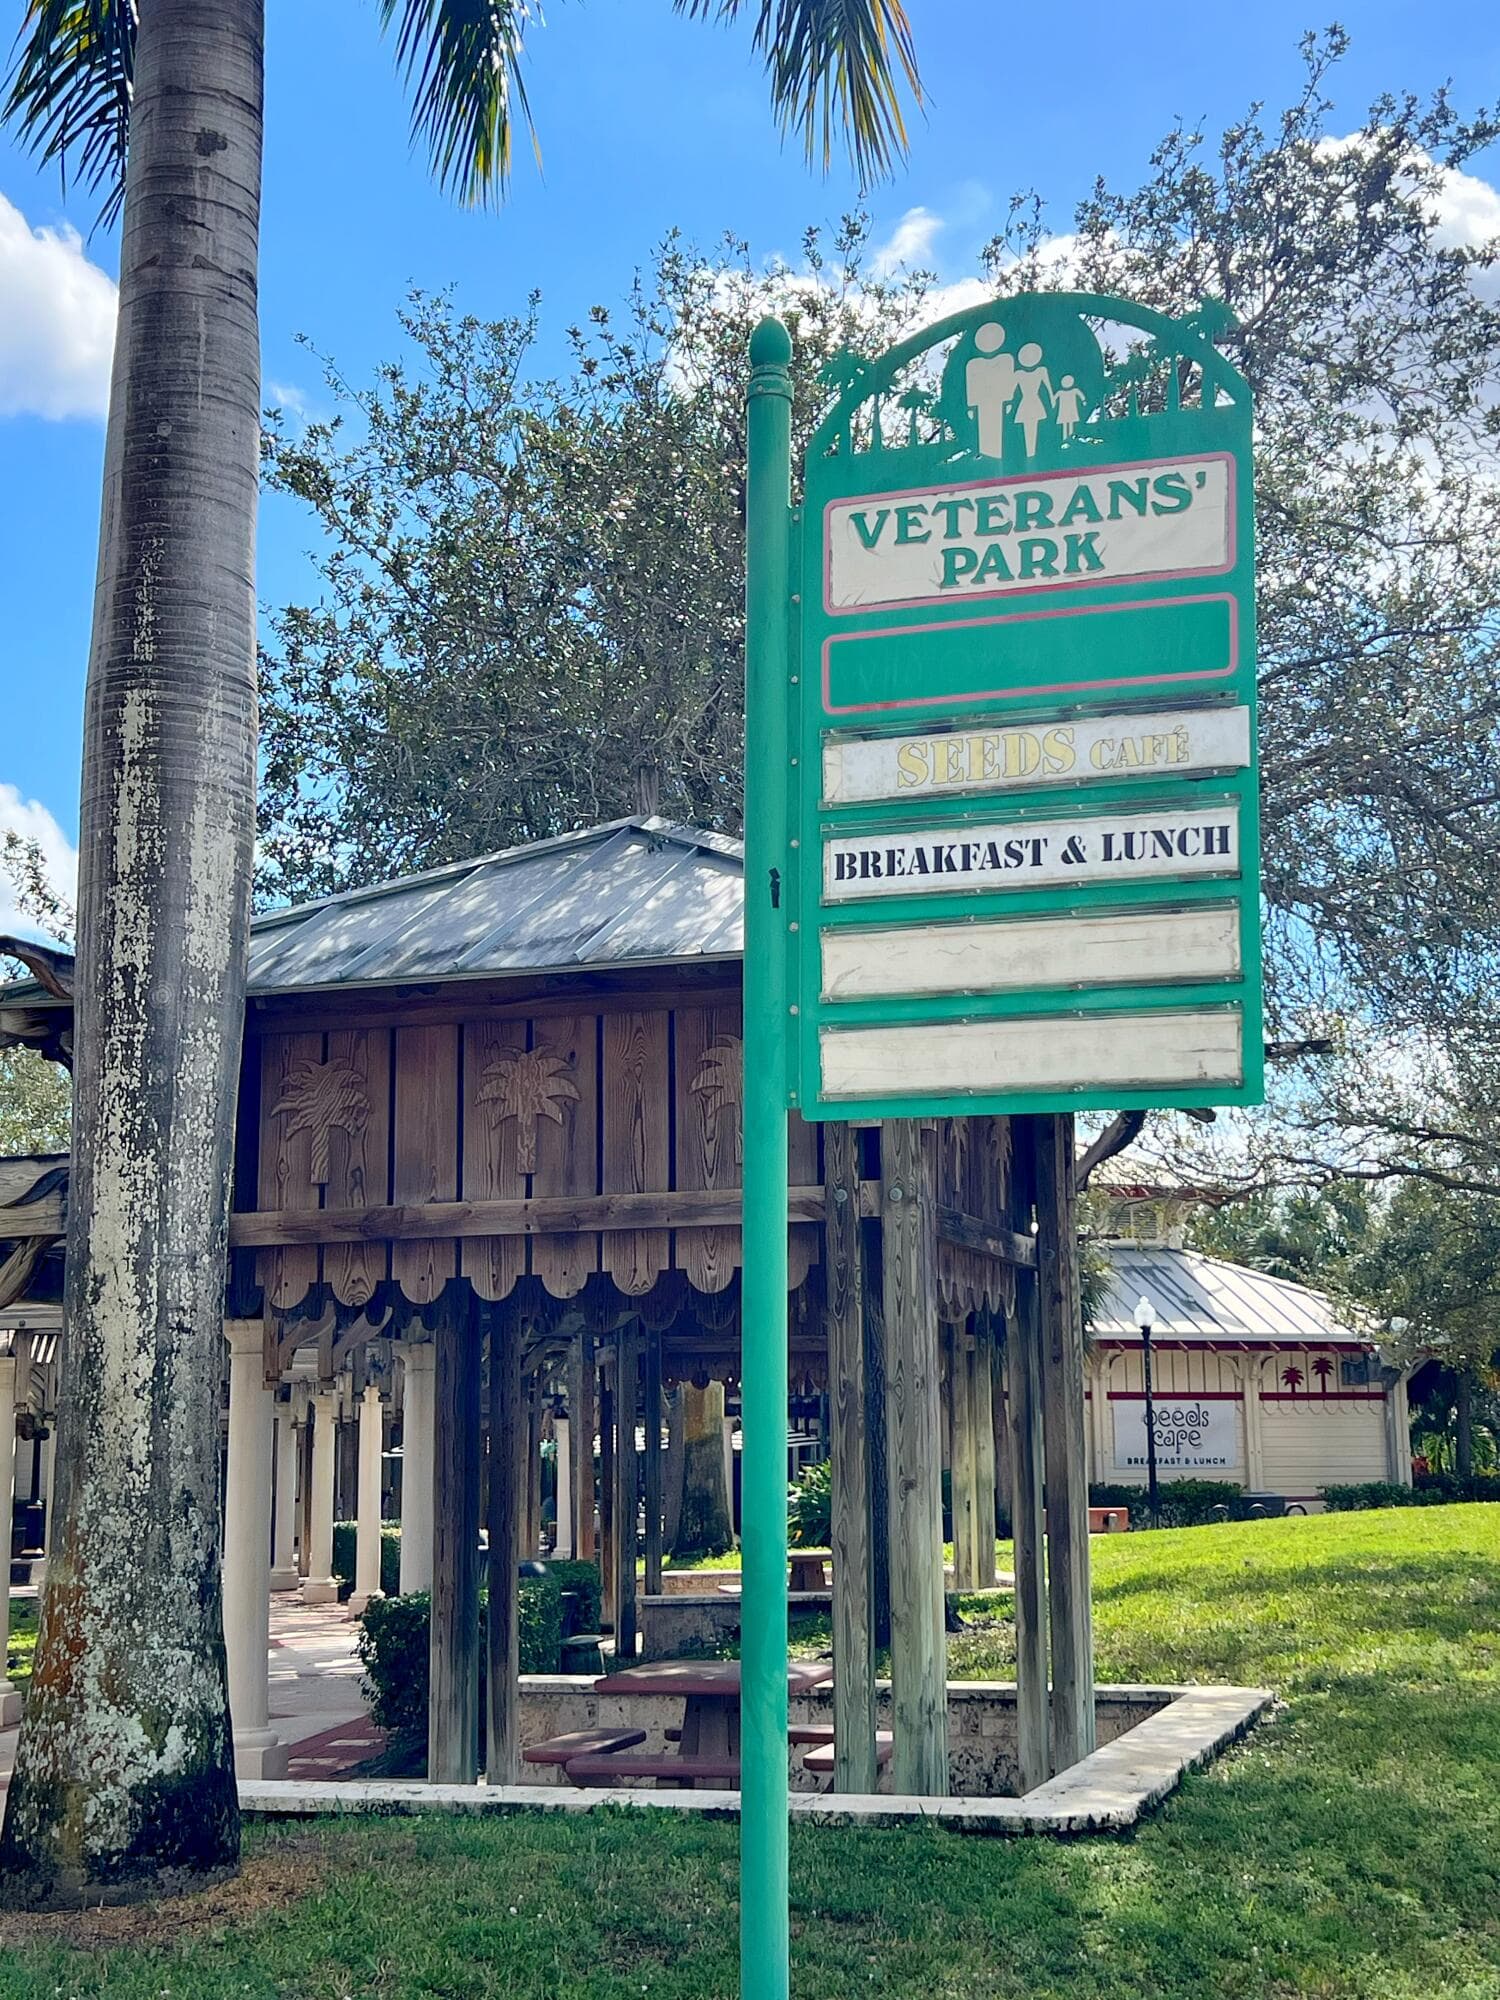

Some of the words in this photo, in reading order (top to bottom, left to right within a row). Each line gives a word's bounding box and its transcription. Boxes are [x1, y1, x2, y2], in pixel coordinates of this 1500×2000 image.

[848, 470, 1207, 550] VETERANS'
[940, 531, 1105, 590] PARK
[896, 727, 1077, 789] SEEDS
[1089, 725, 1190, 771] CAFÉ
[834, 838, 1048, 881] BREAKFAST
[1060, 835, 1087, 865] &
[1101, 825, 1232, 863] LUNCH
[1194, 1457, 1226, 1465] LUNCH
